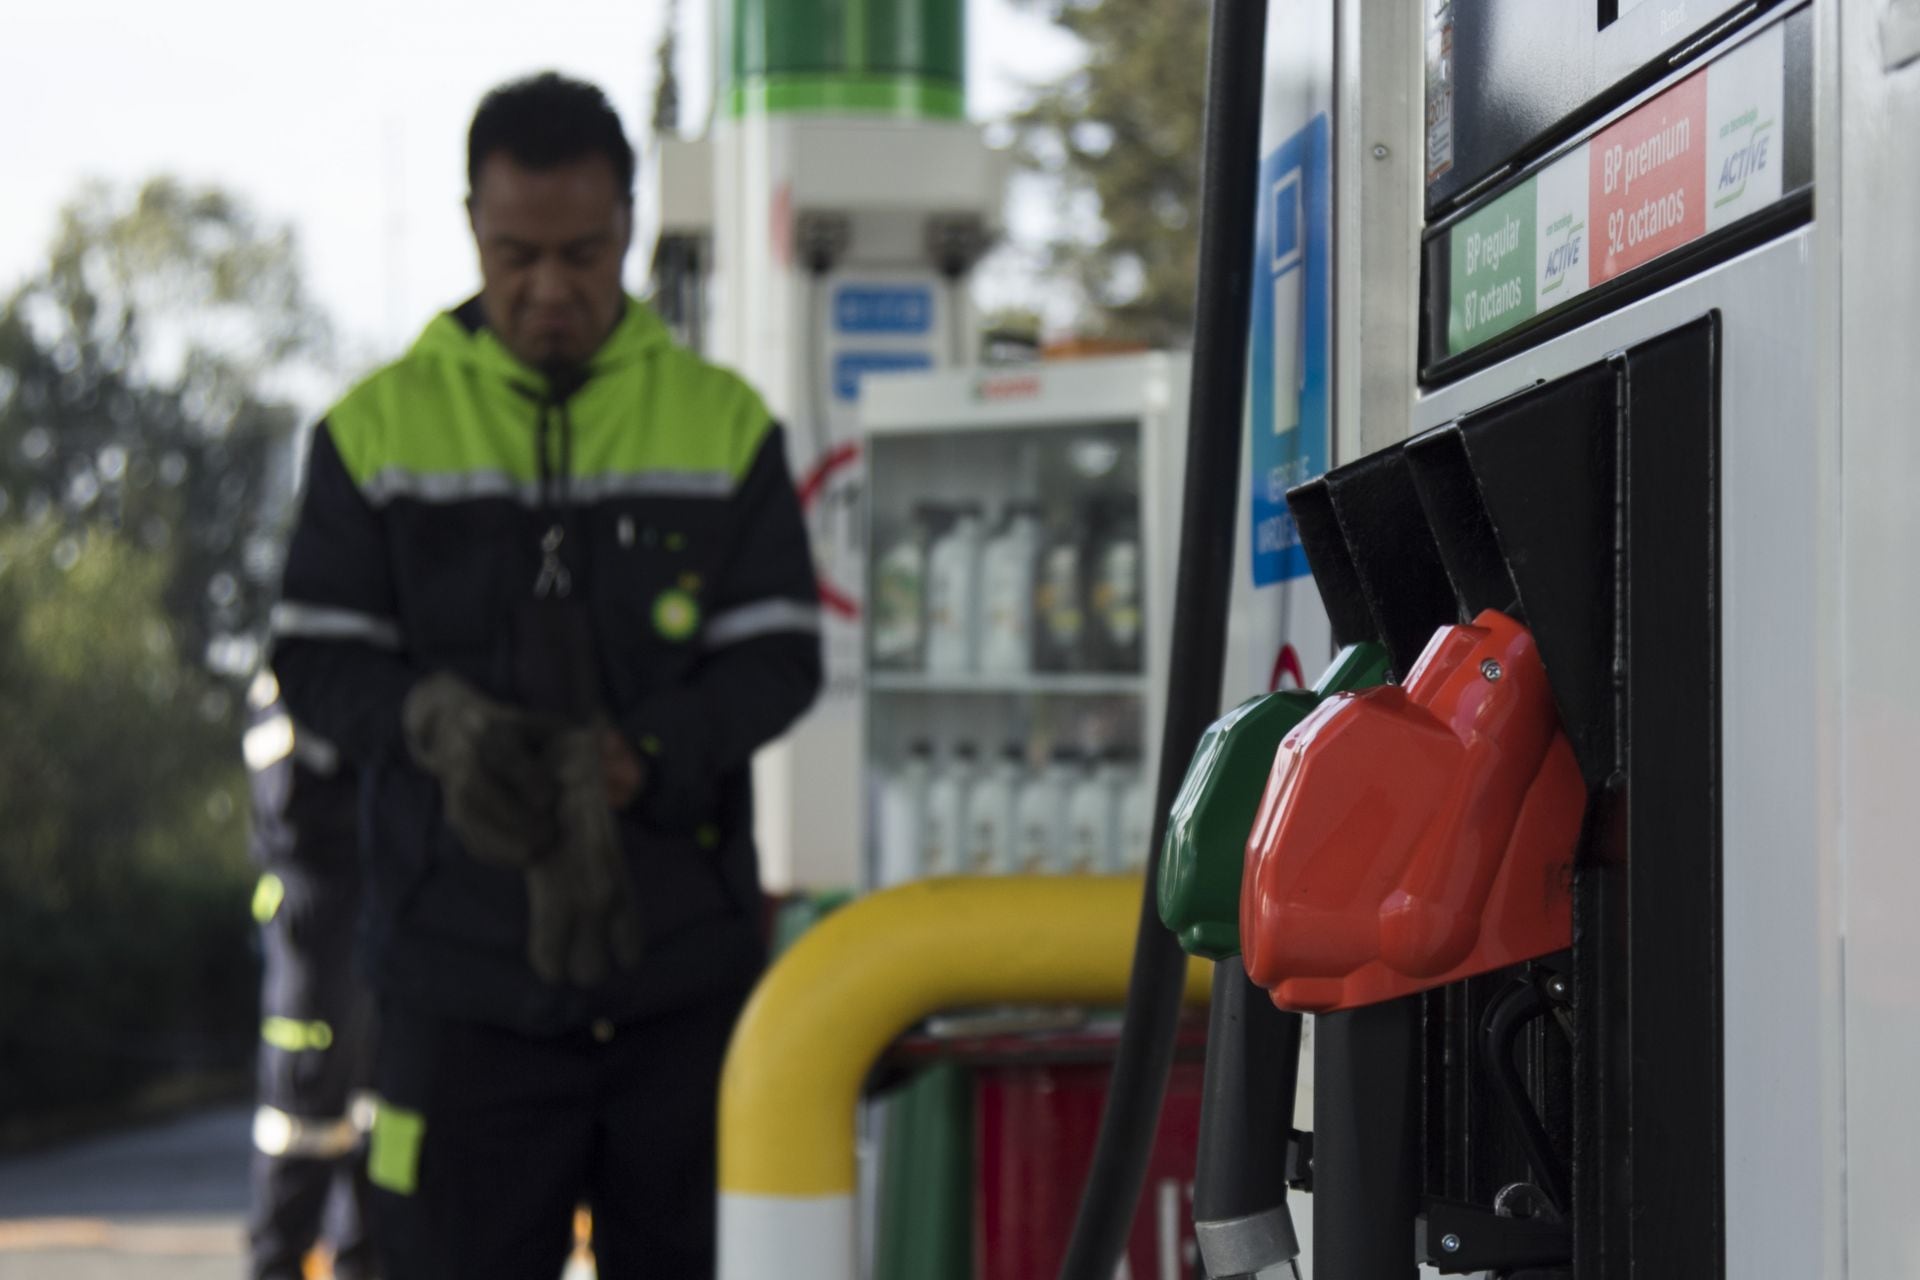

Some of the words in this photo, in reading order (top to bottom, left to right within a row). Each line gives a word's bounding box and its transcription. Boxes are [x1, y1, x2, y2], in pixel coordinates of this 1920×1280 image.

[1603, 143, 1623, 195] BP
[1624, 116, 1690, 196] premium
[1718, 135, 1770, 191] ACTIVE
[1466, 231, 1480, 276] BP
[1482, 213, 1521, 272] regular
[1608, 207, 1624, 257] 92
[1627, 187, 1685, 247] octanos
[1544, 236, 1582, 281] ACTIVE
[1465, 289, 1477, 332] 87
[1480, 276, 1521, 324] octanos
